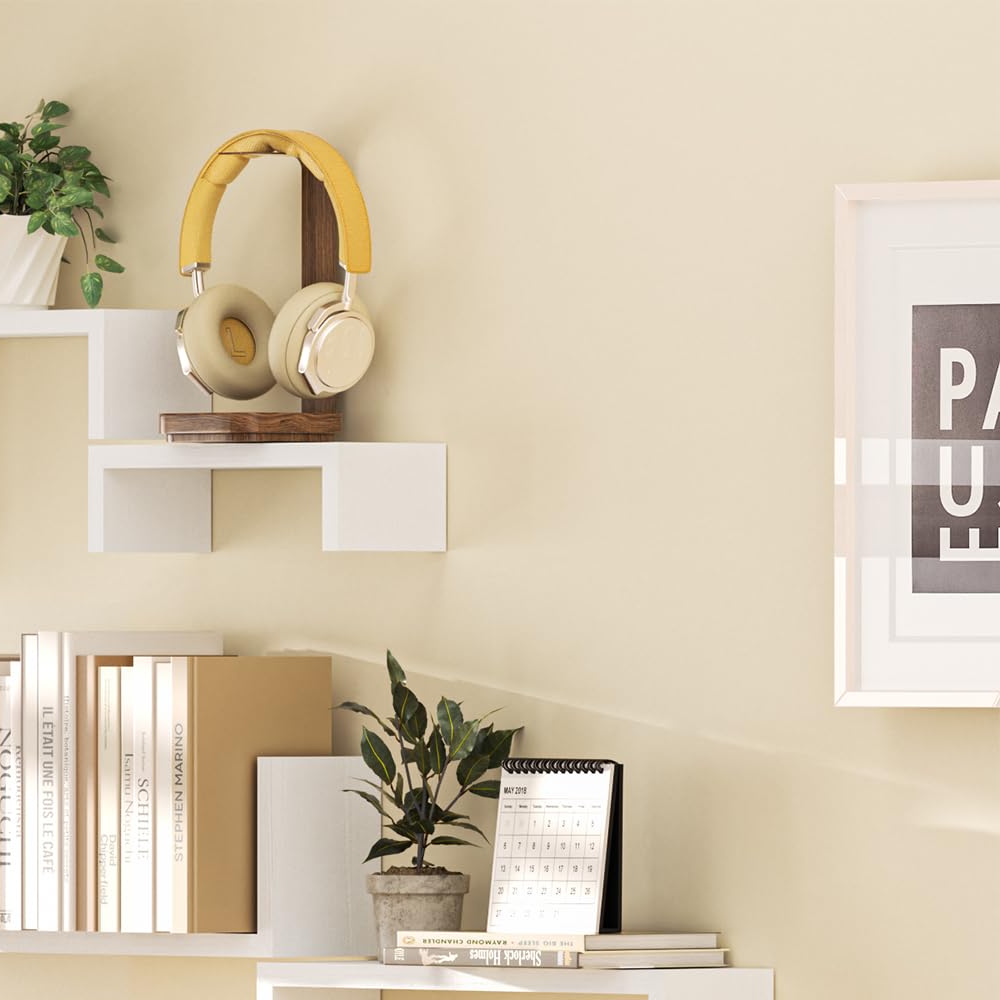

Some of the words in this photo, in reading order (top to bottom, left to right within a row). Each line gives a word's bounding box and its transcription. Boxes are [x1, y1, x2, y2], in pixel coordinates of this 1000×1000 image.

[939, 445, 1000, 518] U
[42, 706, 54, 718] IL
[42, 721, 56, 758] ÉTAIT
[174, 723, 184, 786] MARINO
[42, 761, 54, 787] UNE
[124, 753, 134, 797] Isamu
[0, 728, 12, 867] NOGUCHI
[42, 790, 54, 819] FOIS
[504, 786, 515, 795] MAY
[42, 822, 54, 840] LE
[122, 800, 134, 864] Noguchi
[137, 777, 150, 860] SCHIELE
[174, 791, 184, 862] STEPHEN
[42, 842, 56, 873] CAFÉ
[108, 834, 117, 867] David
[98, 834, 109, 905] Chipperfield
[466, 938, 508, 946] RAYMOND
[469, 948, 501, 966] Holmes
[504, 949, 542, 967] Sherlock
[517, 939, 542, 947] SLEEP
